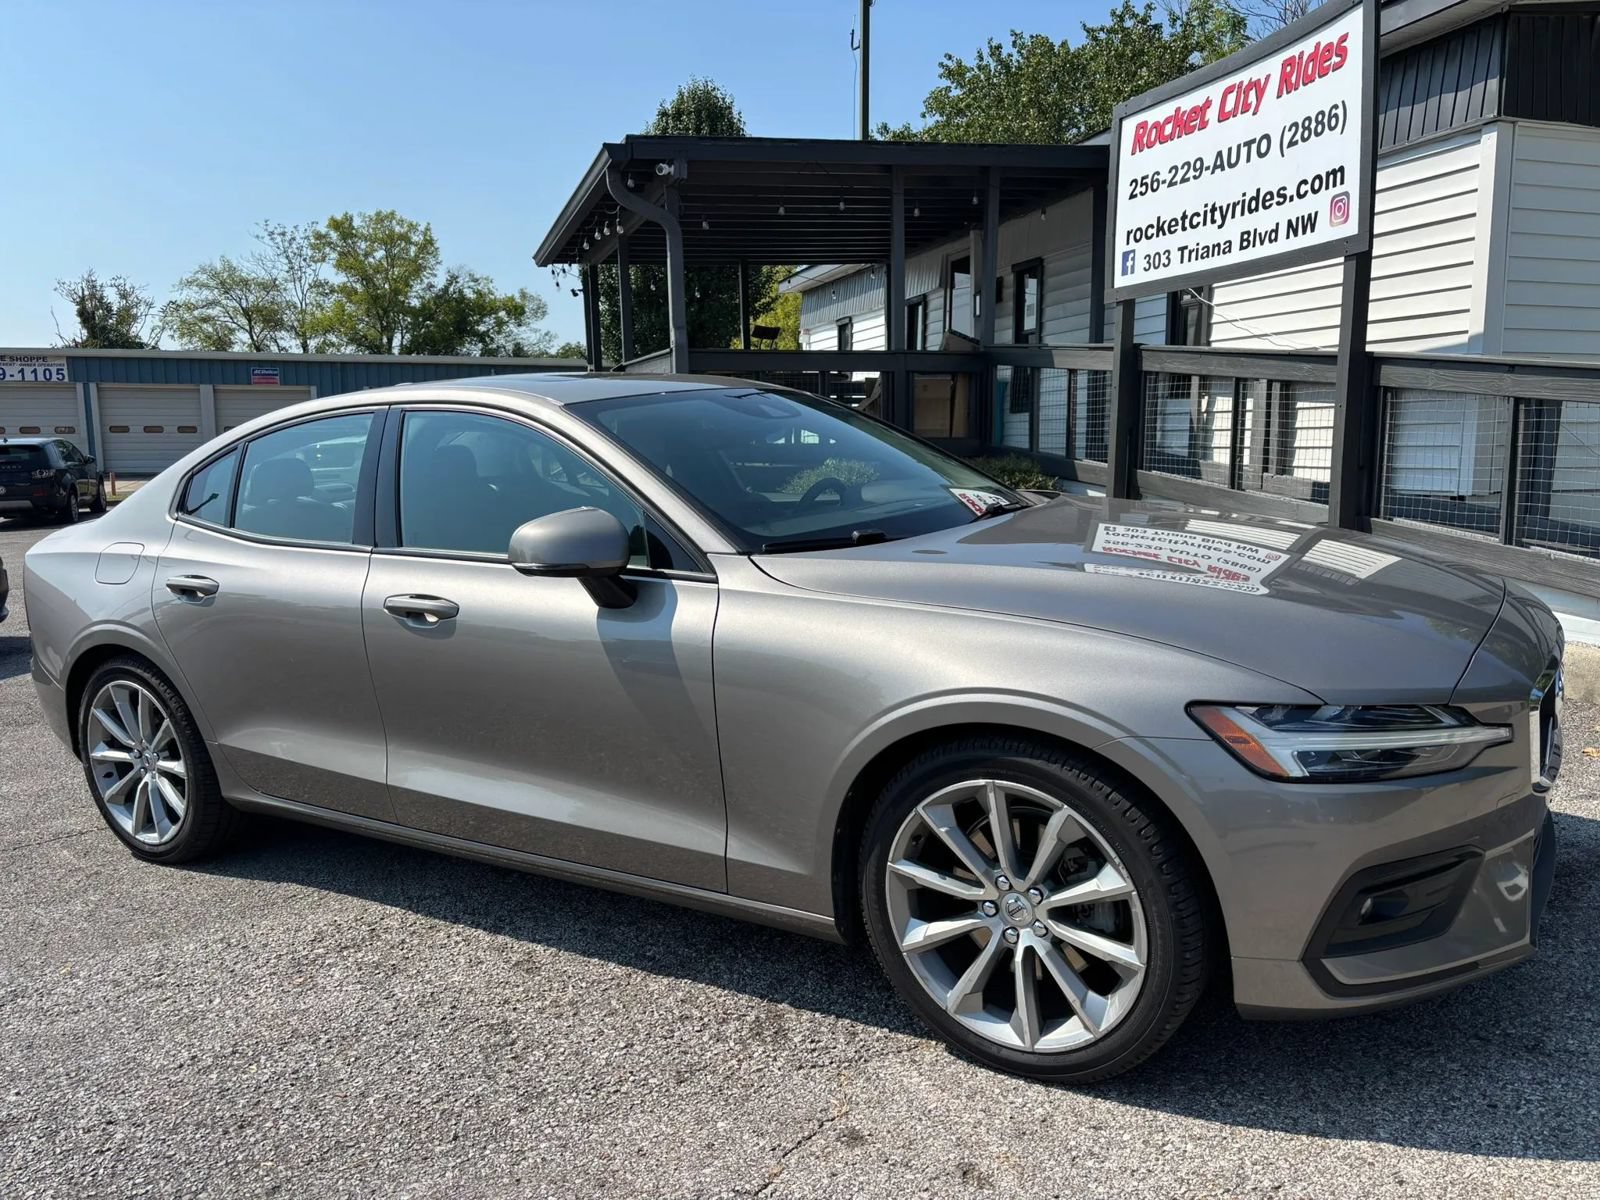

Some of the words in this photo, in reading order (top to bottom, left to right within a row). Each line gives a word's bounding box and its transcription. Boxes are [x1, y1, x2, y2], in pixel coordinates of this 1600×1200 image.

[1130, 96, 1213, 156] Rocket
[1217, 73, 1271, 123] City
[1276, 32, 1349, 99] Rides
[1128, 133, 1272, 200] 256-229-AUTO
[1279, 100, 1347, 158] (2886)
[1125, 165, 1346, 246] rocketcityrides.com
[1143, 249, 1171, 272] 303
[1177, 239, 1232, 265] Triana
[1239, 221, 1280, 252] Blvd
[1285, 210, 1319, 240] NW
[0, 367, 66, 381] 9-1105
